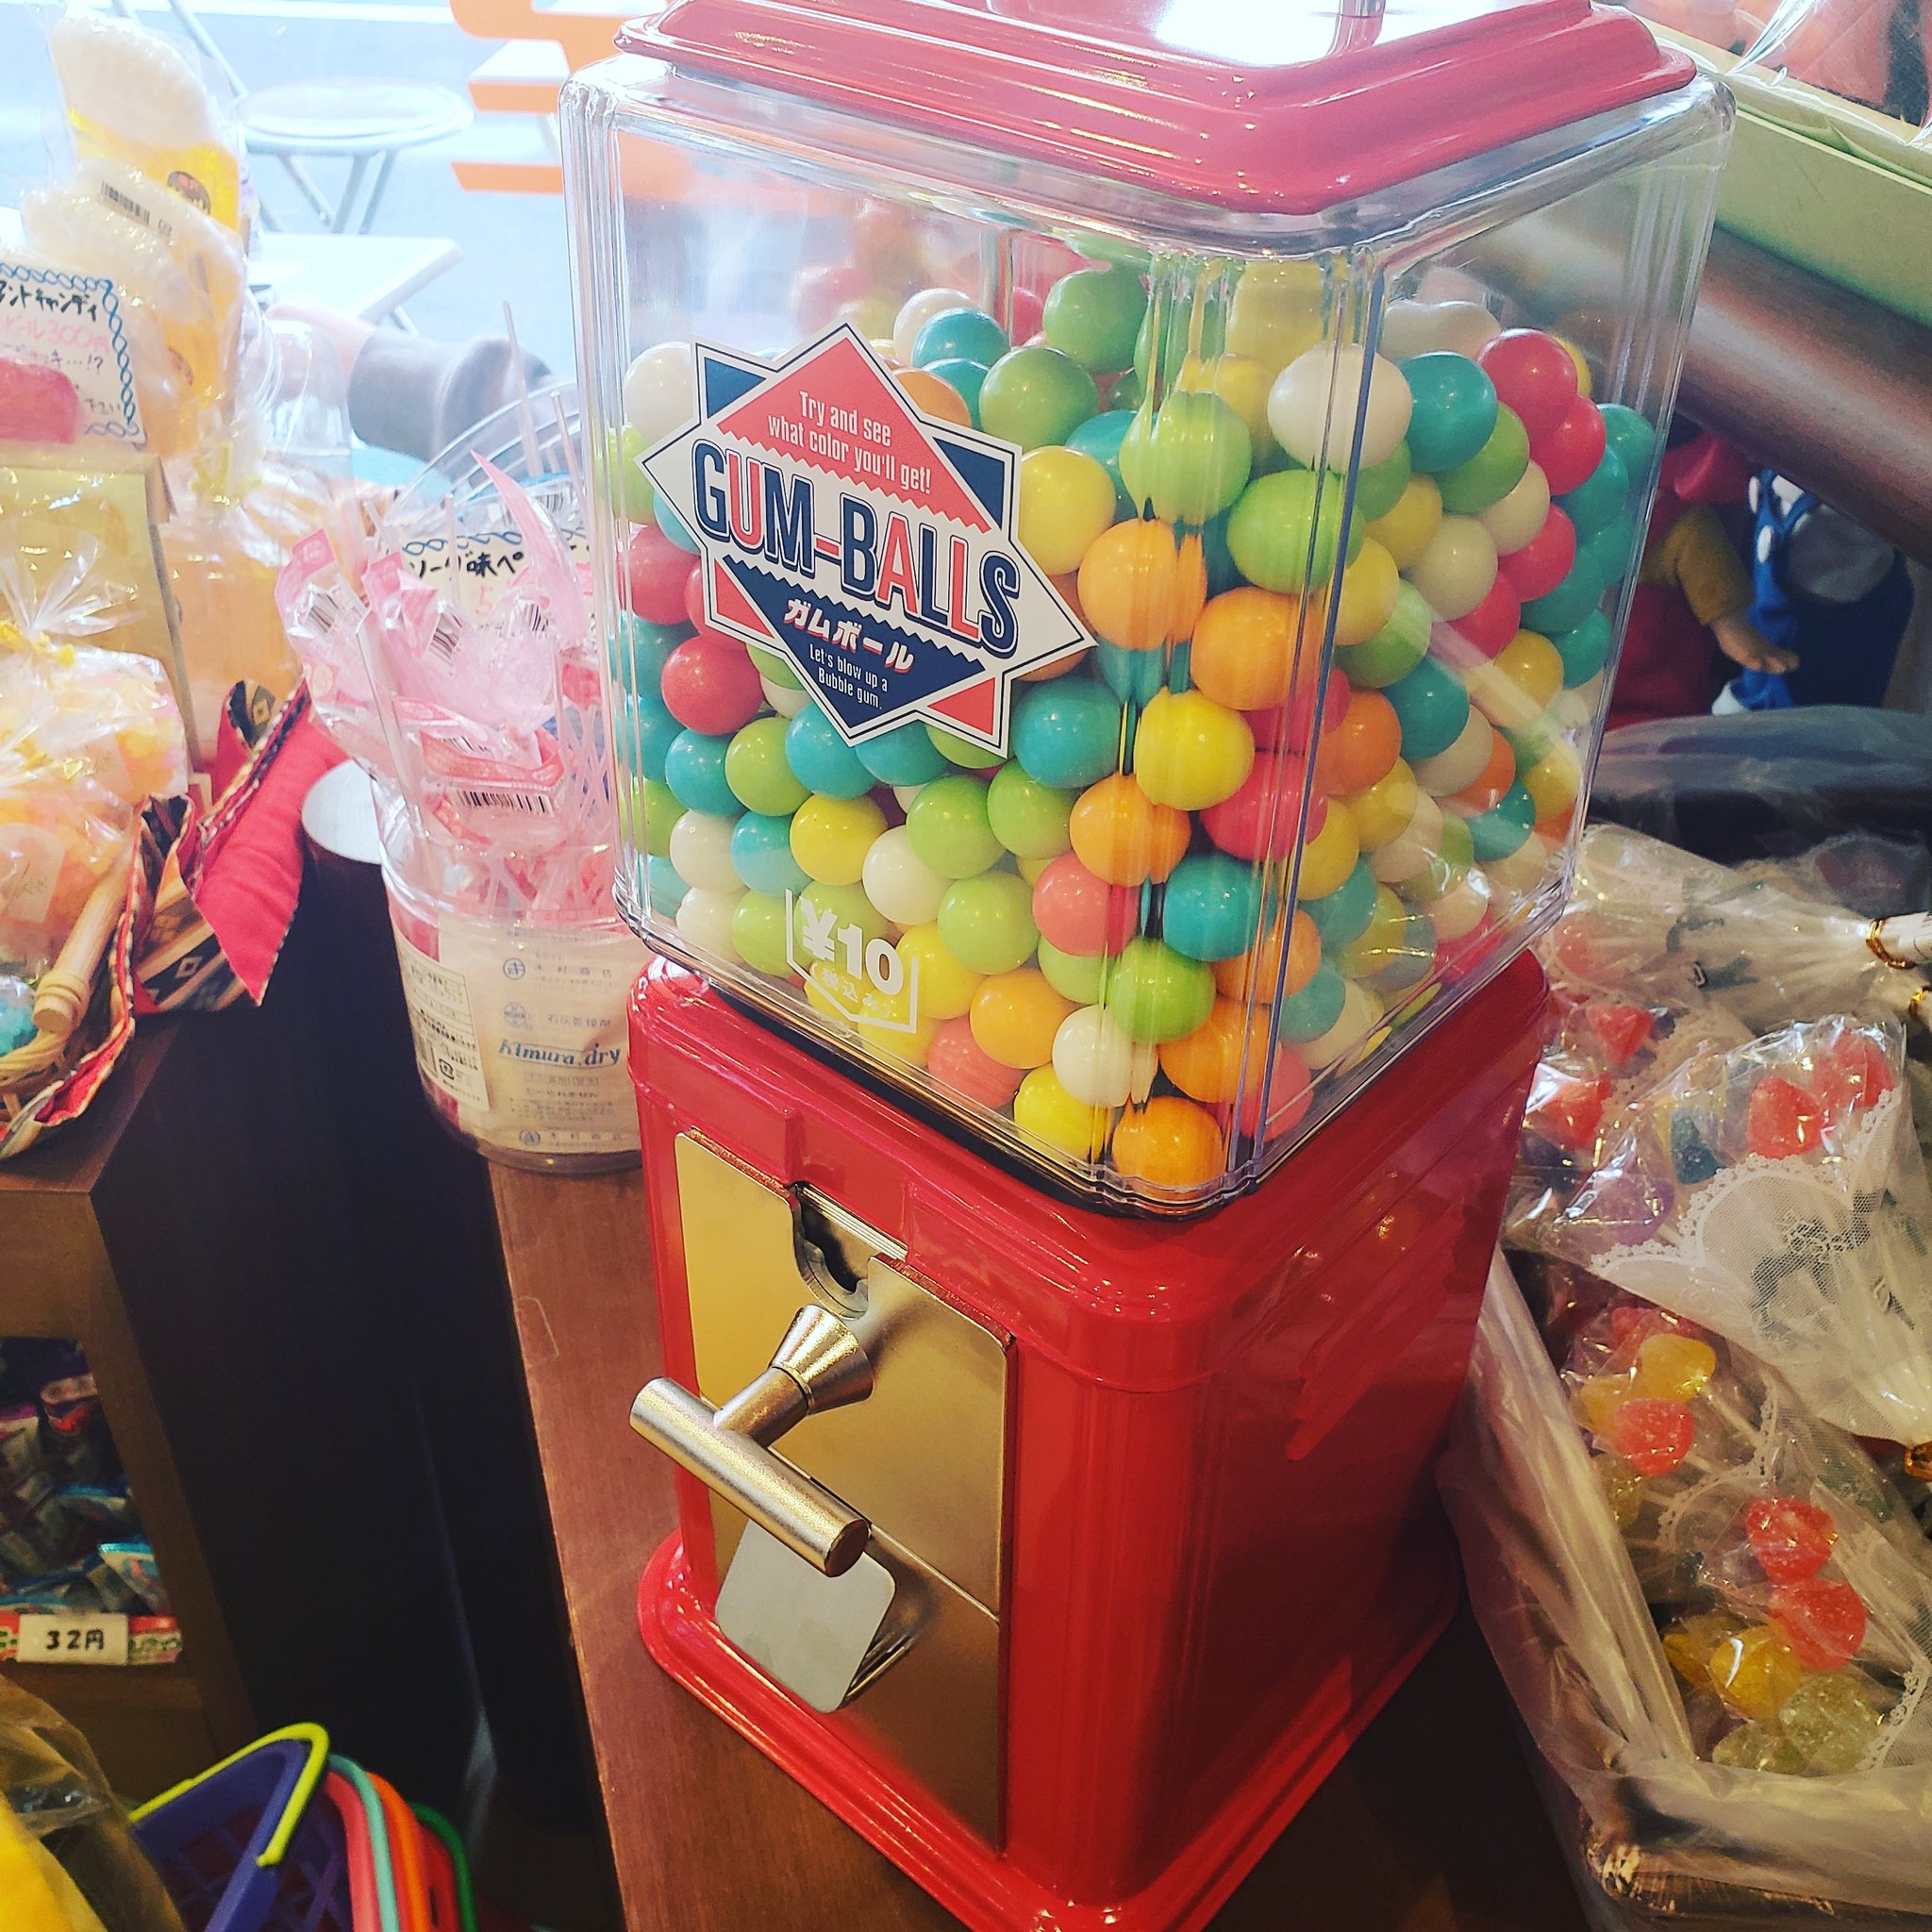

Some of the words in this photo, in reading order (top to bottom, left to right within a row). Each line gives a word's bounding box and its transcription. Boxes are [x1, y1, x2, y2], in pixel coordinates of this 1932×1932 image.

[800, 391, 824, 426] Try
[830, 406, 858, 435] and
[863, 418, 891, 446] see
[768, 415, 804, 447] what
[808, 430, 849, 463] color
[854, 447, 895, 481] you'll
[901, 463, 931, 494] get!
[691, 440, 1021, 658] GUM-BALLS
[784, 598, 914, 674] ガムボール
[809, 643, 833, 668] Let's
[838, 656, 861, 680] blow
[865, 671, 878, 689] up
[881, 678, 888, 691] a
[818, 667, 854, 696] Bubble
[857, 688, 883, 709] gum.
[799, 895, 904, 995] ¥10
[46, 1628, 105, 1650] 32円
